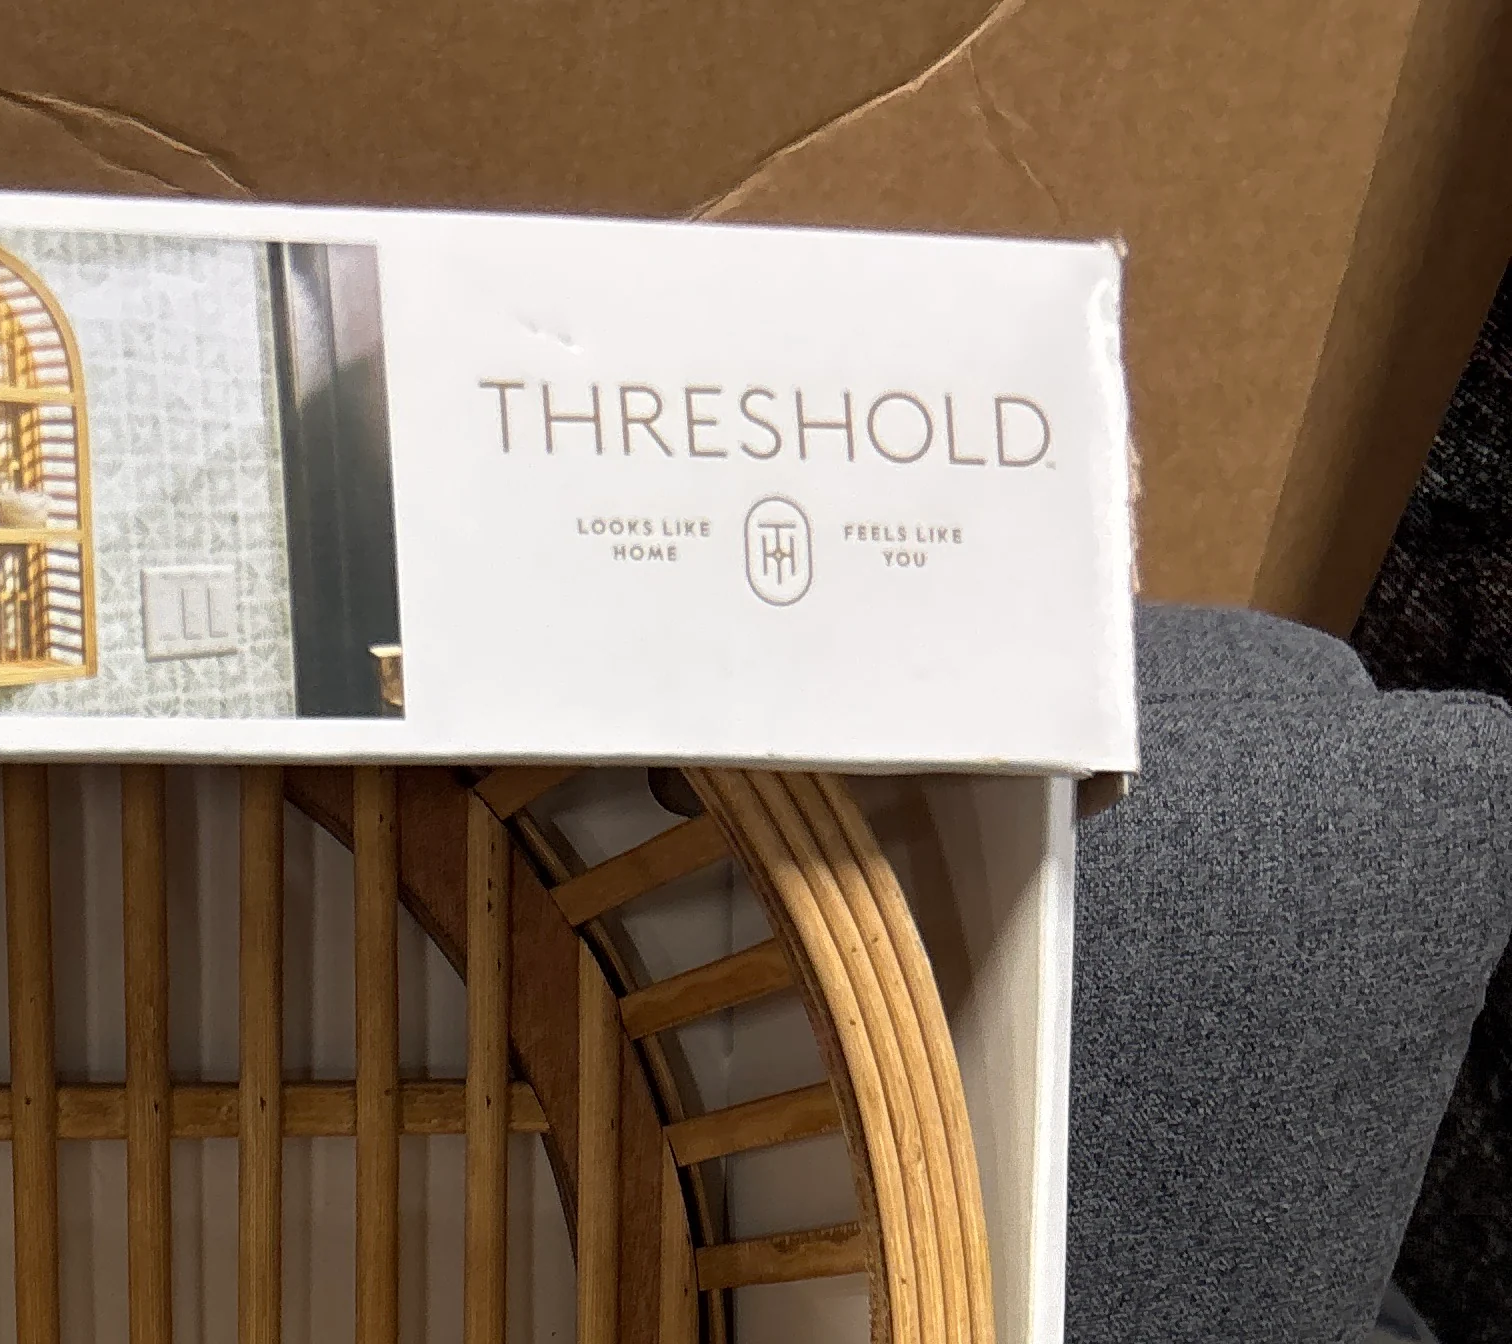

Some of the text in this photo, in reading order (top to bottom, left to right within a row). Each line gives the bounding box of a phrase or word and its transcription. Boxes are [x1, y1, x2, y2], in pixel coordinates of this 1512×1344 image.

[479, 379, 1051, 467] THRESHOLD
[577, 518, 710, 537] LOOKS LIKE
[844, 524, 963, 544] FEELS LIKE
[612, 544, 677, 561] HOME
[883, 550, 928, 567] YOU
